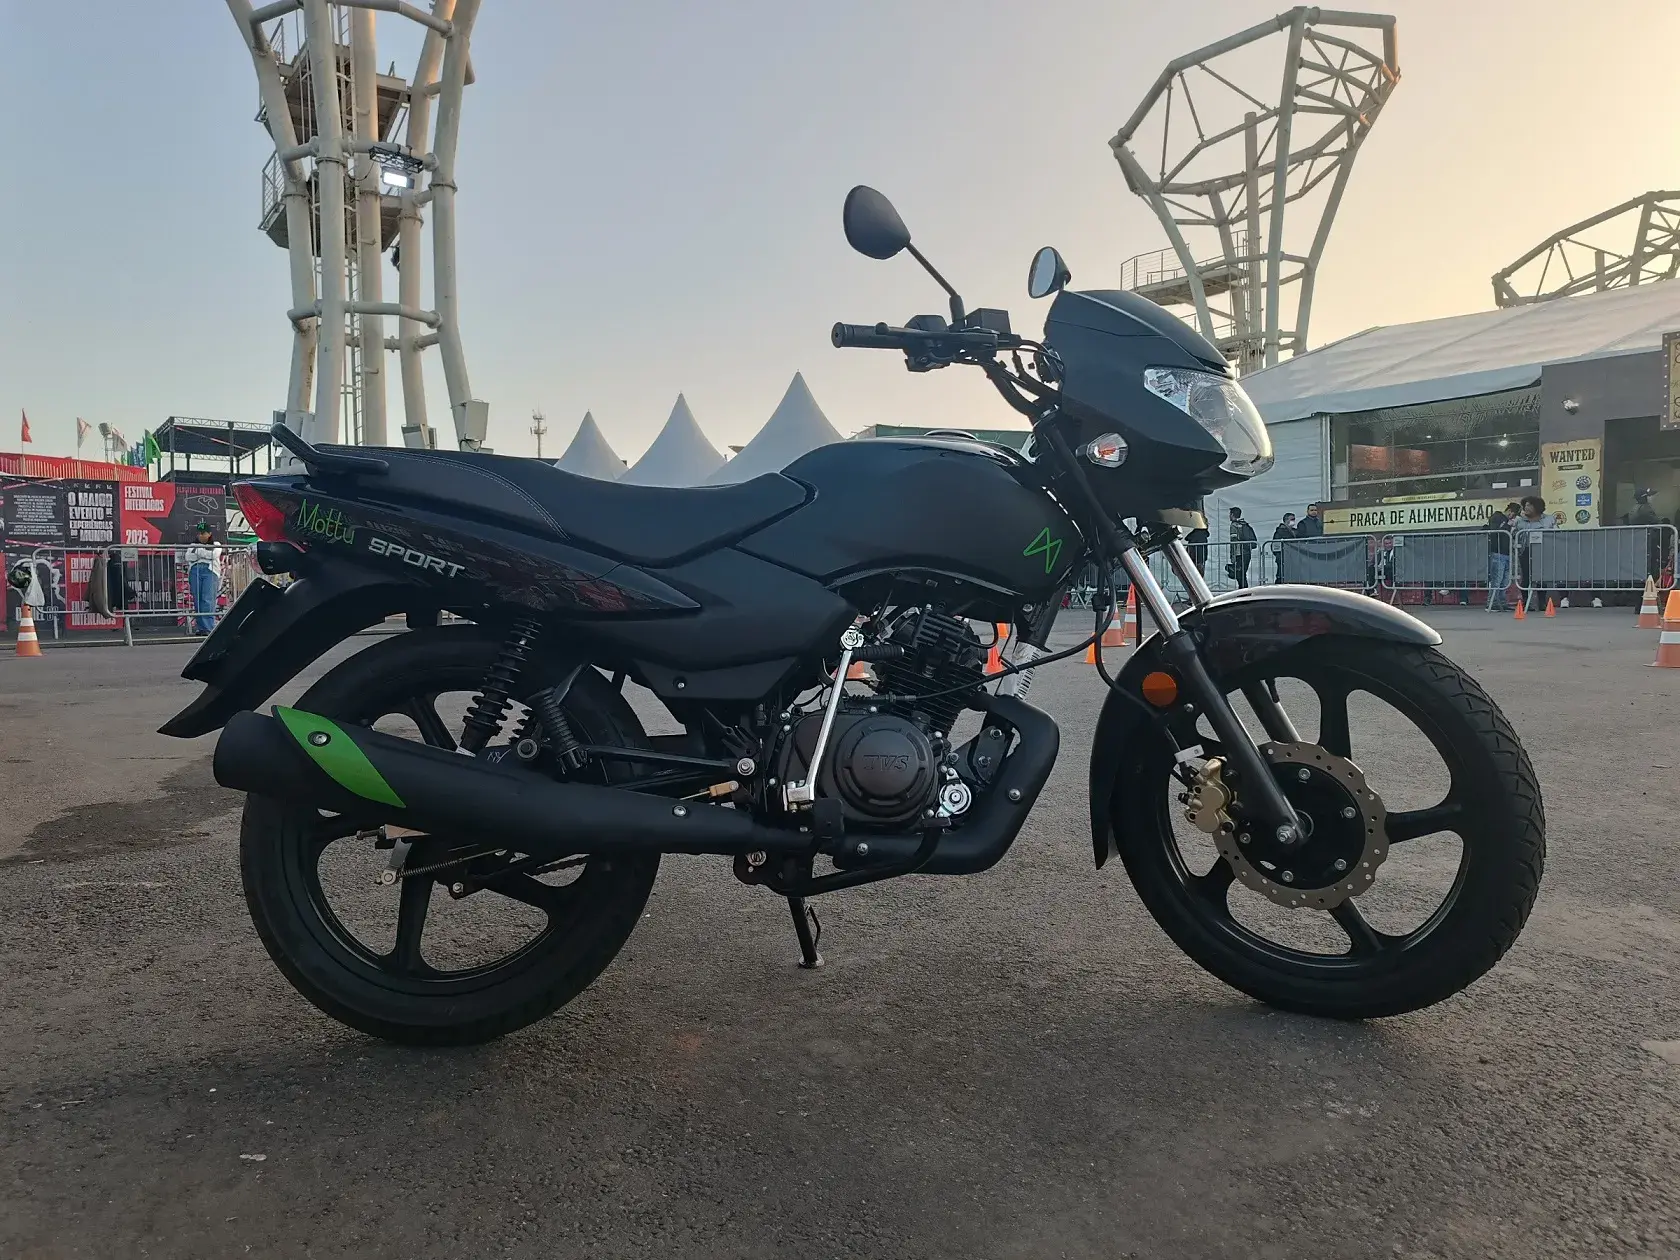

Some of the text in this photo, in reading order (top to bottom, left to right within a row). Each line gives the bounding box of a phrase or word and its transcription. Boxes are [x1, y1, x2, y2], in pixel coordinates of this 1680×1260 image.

[1550, 448, 1595, 463] WANTED
[67, 491, 113, 507] O MAIOR
[125, 486, 153, 499] FESTIVAL
[125, 499, 165, 511] INTERLAGOS
[69, 507, 104, 520] EVENTO
[1390, 510, 1405, 525] DE
[297, 499, 355, 545] Mottu
[79, 530, 113, 542] MUNDO
[126, 529, 149, 545] 2025
[368, 537, 465, 578] SPORT
[862, 754, 909, 771] TVS
